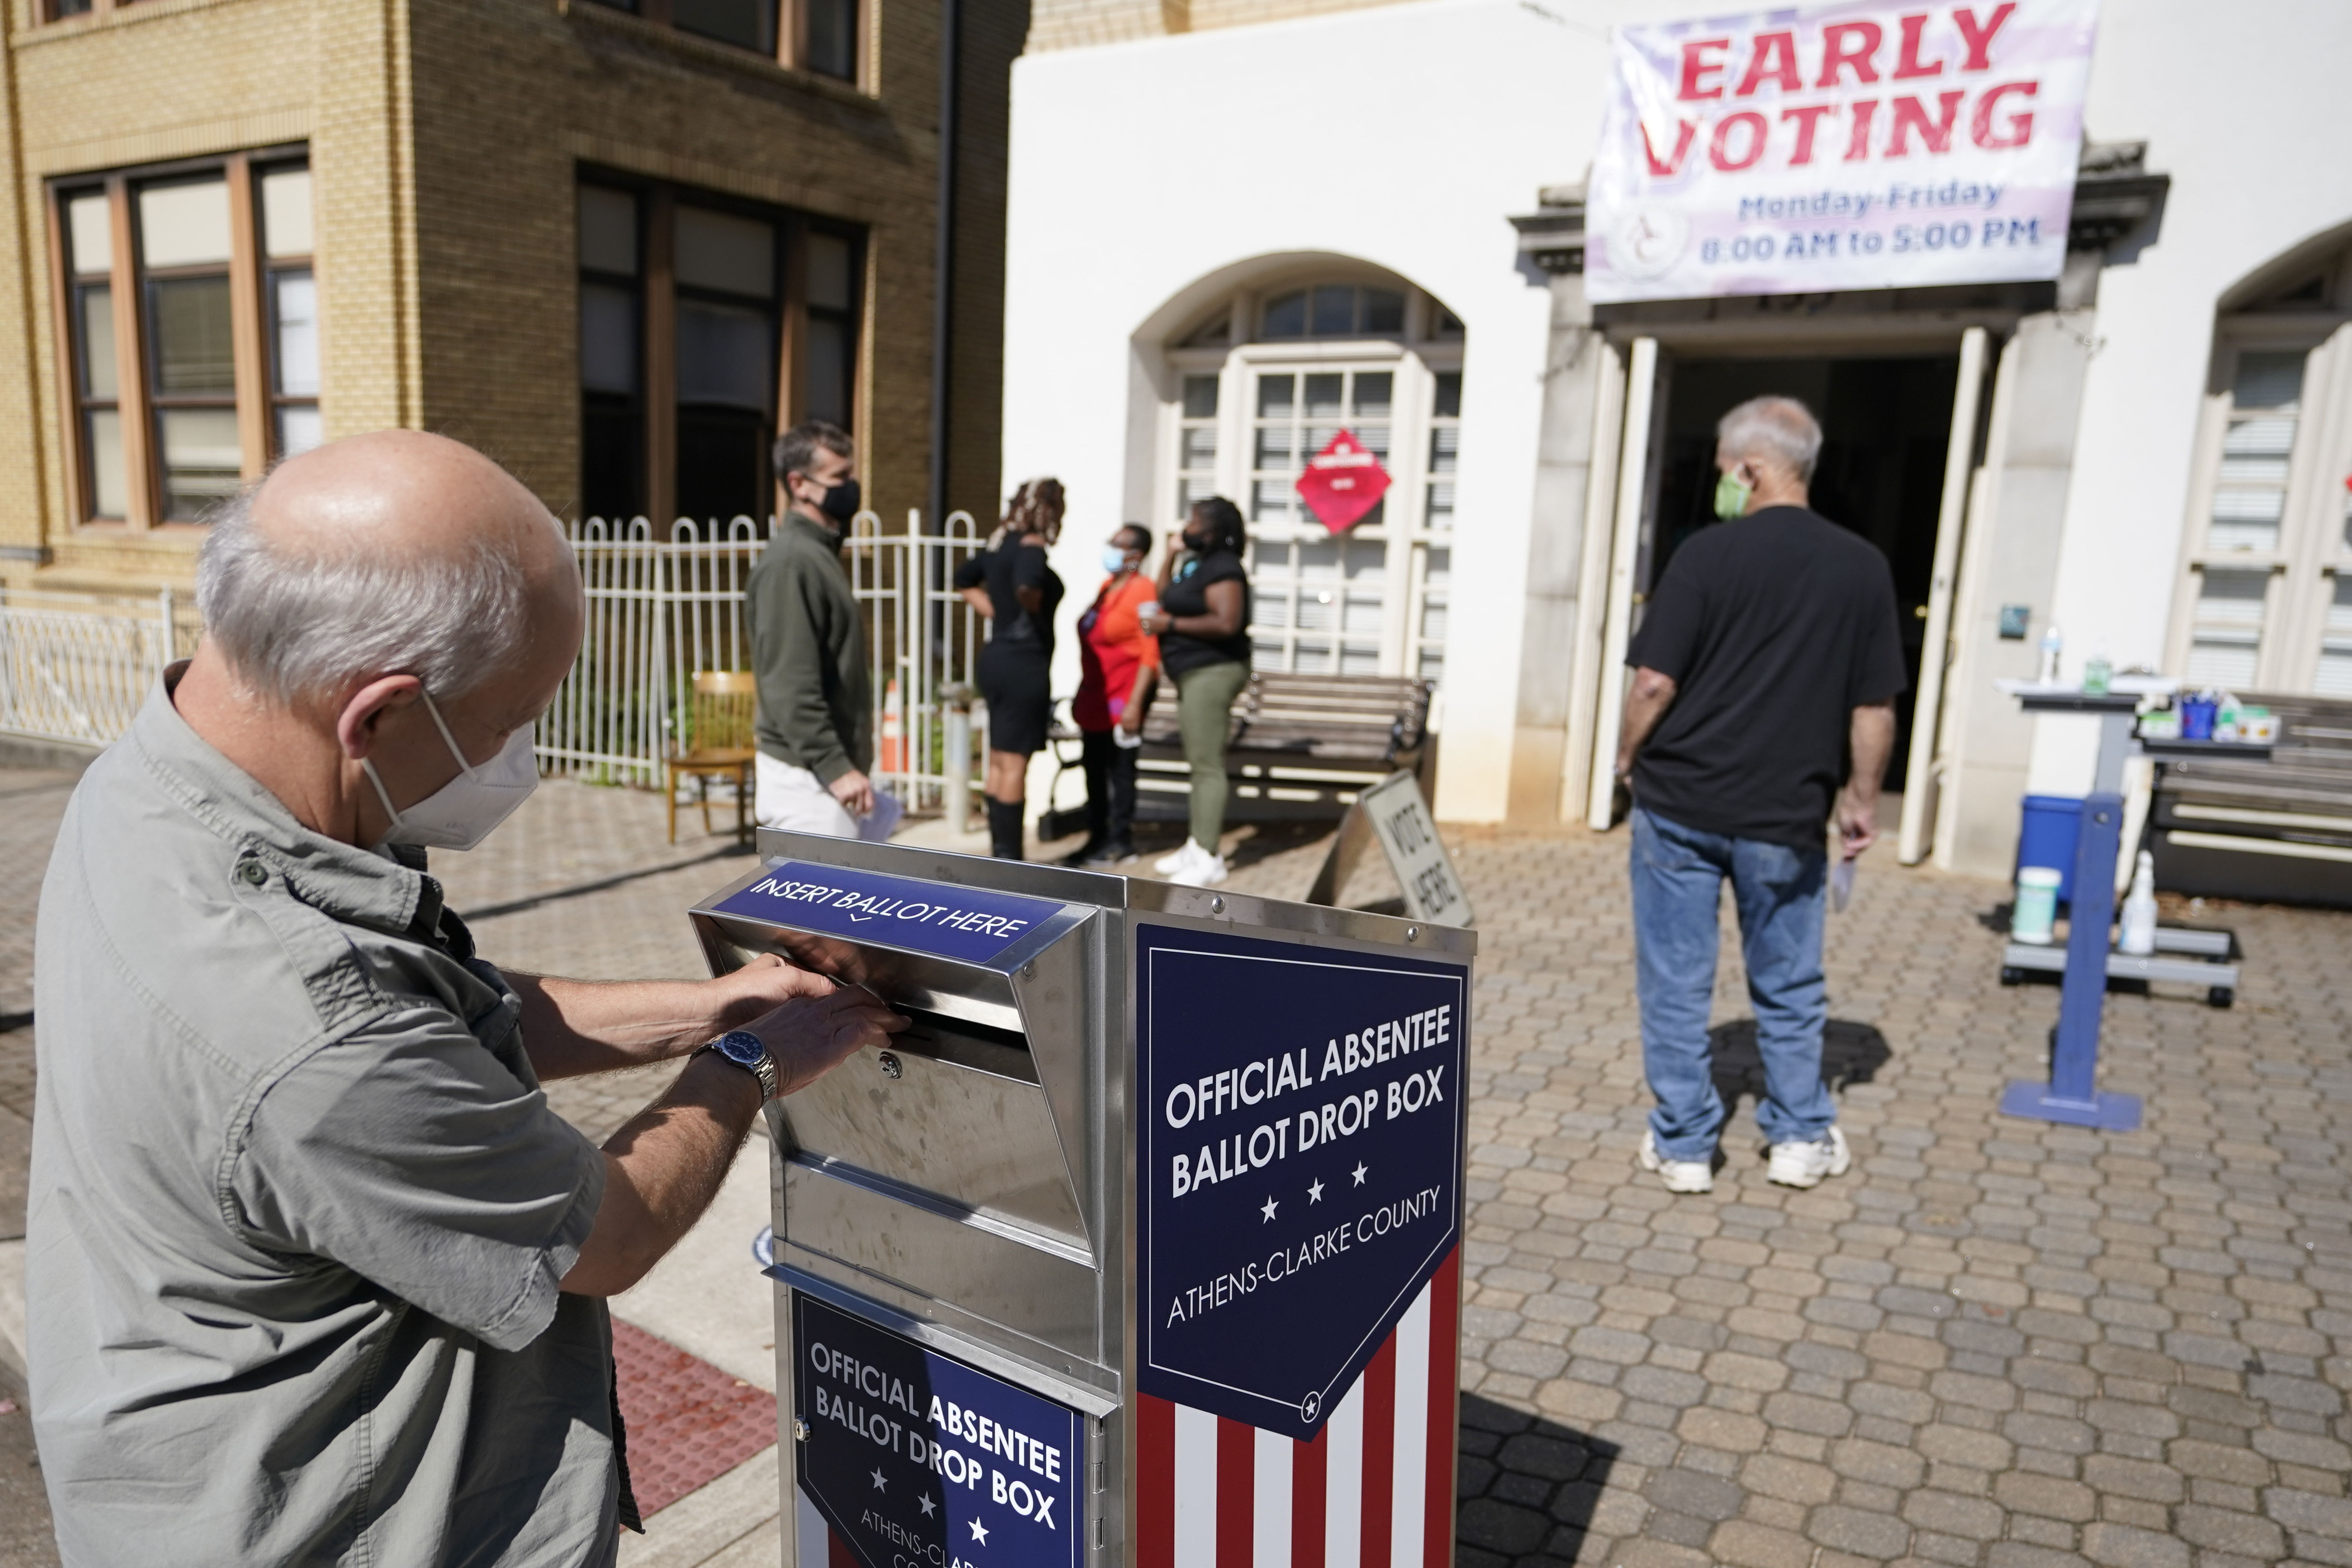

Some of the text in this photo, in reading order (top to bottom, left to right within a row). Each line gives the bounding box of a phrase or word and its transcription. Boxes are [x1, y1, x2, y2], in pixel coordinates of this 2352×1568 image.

[1677, 2, 2017, 101] EARLY
[1639, 81, 2039, 177] VOTING
[1784, 231, 1838, 259] AM
[1849, 230, 1883, 254] to
[1981, 217, 2041, 248] PM
[750, 878, 1028, 938] INSERT BALLOT HERE
[1166, 1004, 1450, 1129] OFFICIAL ABSENTEE
[1173, 1065, 1444, 1198] BALLOT DROP BOX
[1167, 1185, 1440, 1329] ATHENS-CLARKE COUNTY
[811, 1342, 1060, 1483] OFFICIAL ABSENTEE
[817, 1385, 1056, 1530] BALLOT DROP BOX
